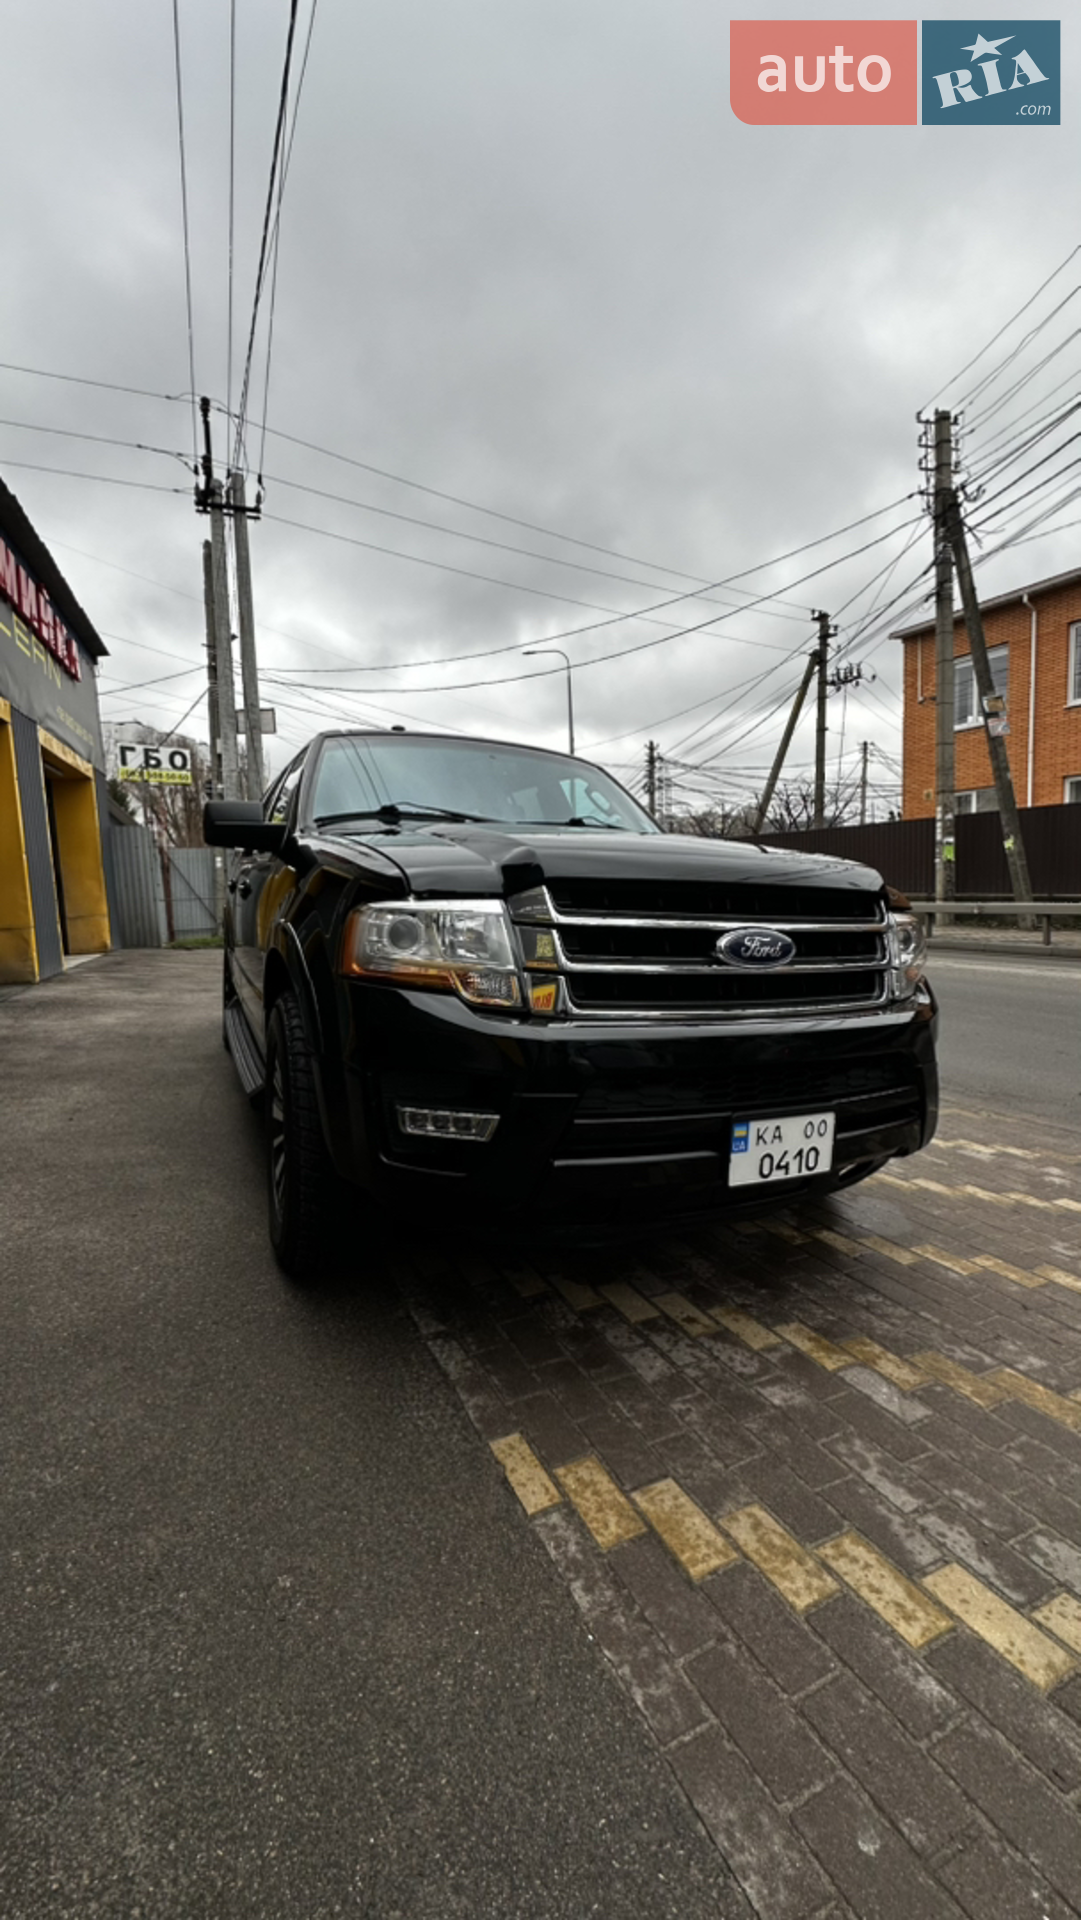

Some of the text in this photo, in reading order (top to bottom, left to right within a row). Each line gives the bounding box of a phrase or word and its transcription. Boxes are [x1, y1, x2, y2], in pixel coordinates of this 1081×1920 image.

[119, 745, 188, 771] ГБО
[740, 935, 783, 958] Ford
[755, 1119, 828, 1146] KA 00
[759, 1146, 820, 1179] 0410
